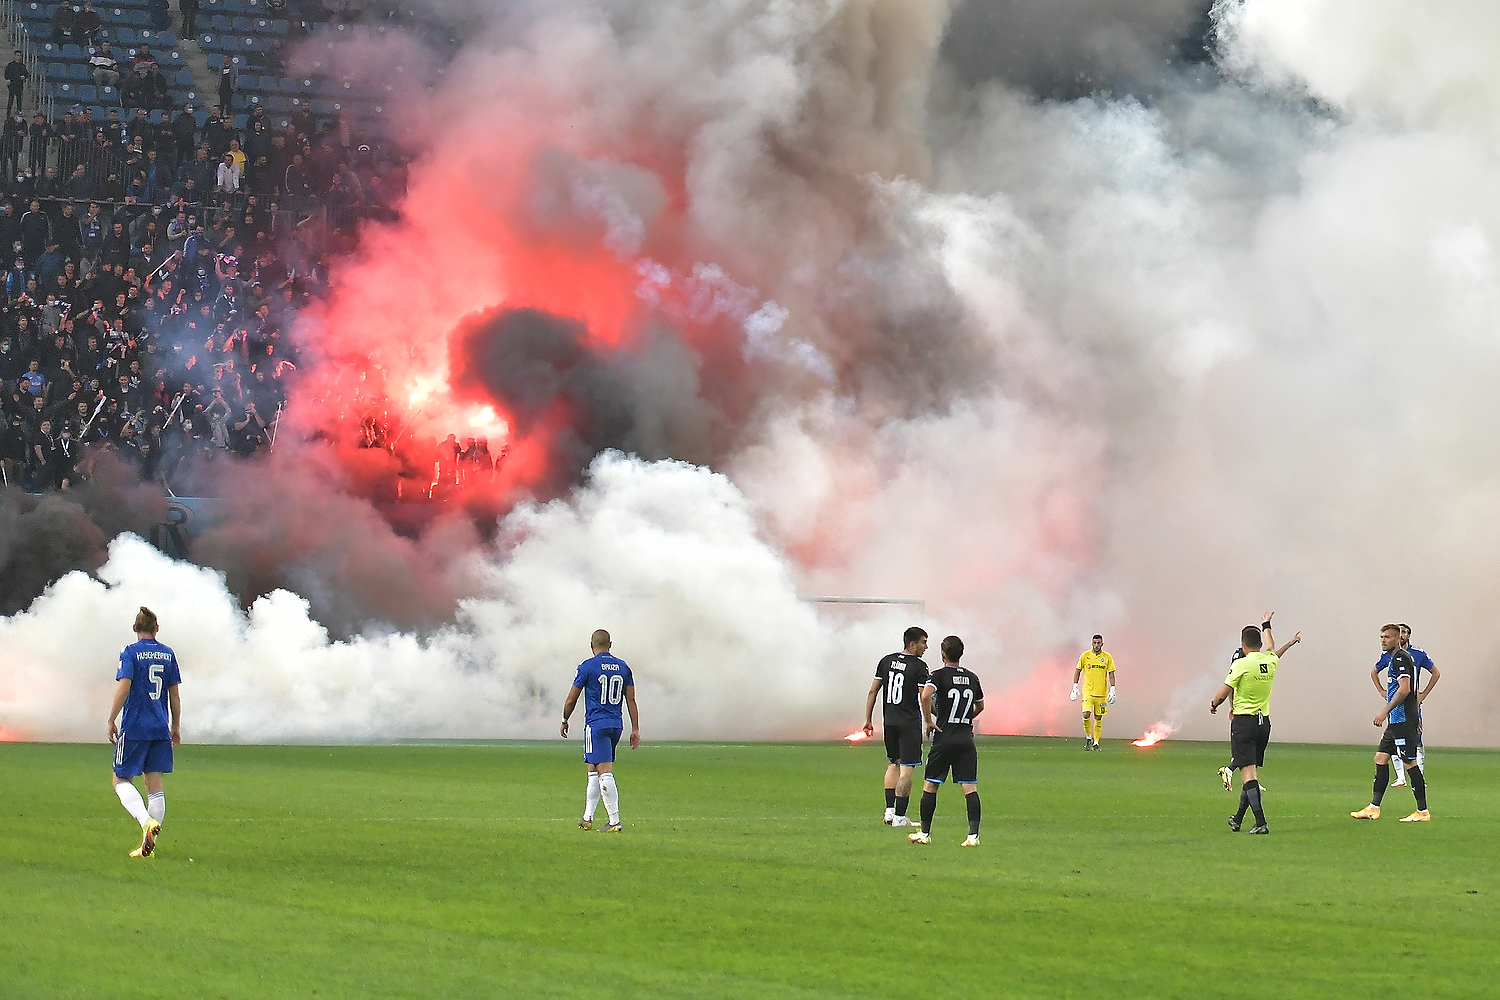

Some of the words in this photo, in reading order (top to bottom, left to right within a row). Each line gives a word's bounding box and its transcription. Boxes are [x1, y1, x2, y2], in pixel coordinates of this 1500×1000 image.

[148, 664, 165, 700] 5
[598, 673, 623, 705] 10
[886, 670, 905, 705] 18
[947, 688, 974, 725] 22
